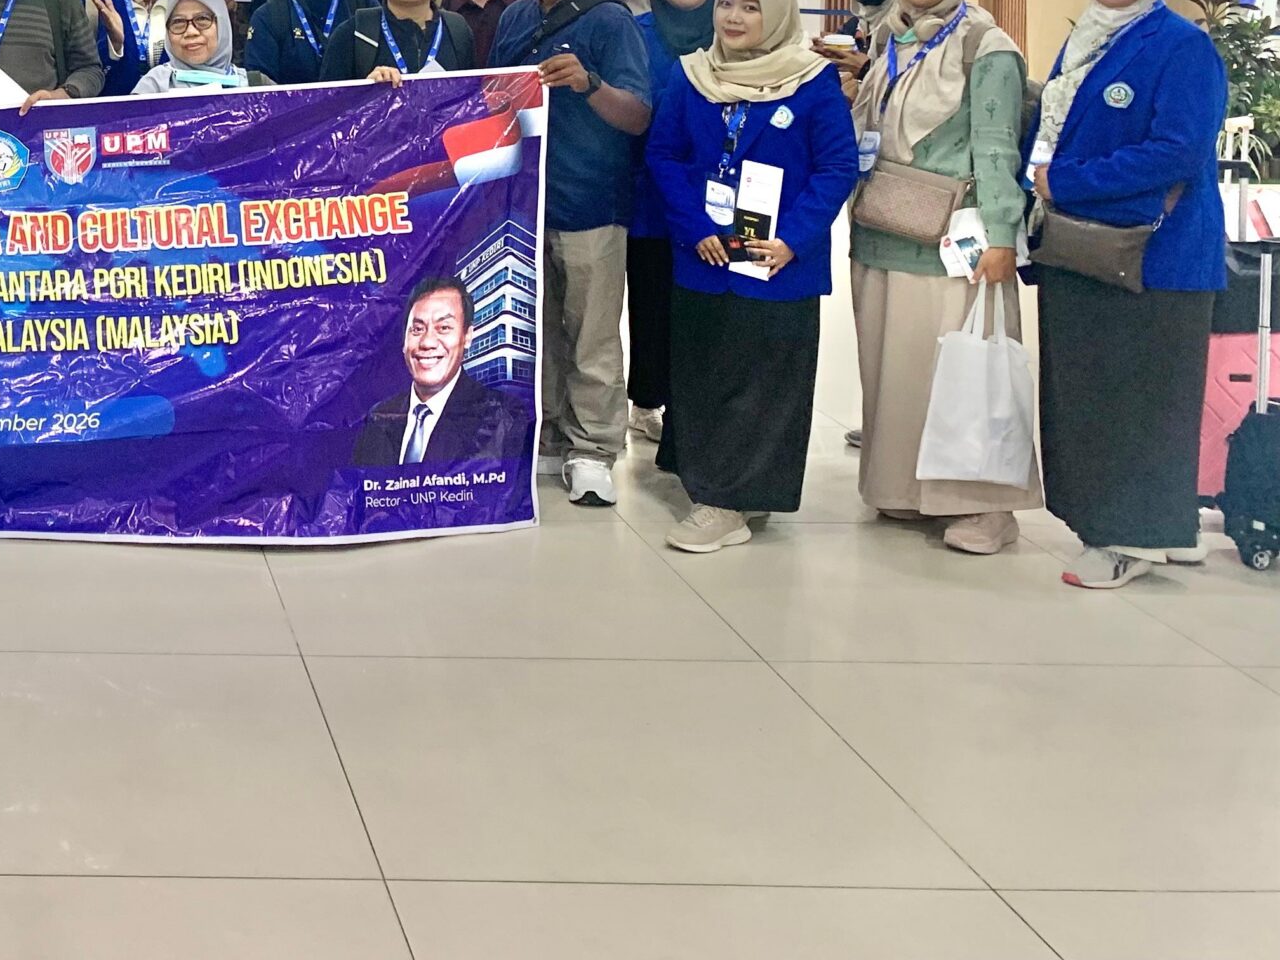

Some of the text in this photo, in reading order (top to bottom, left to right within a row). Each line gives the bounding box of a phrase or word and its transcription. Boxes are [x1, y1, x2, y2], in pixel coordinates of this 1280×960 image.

[45, 130, 68, 139] UPM
[104, 133, 167, 152] UPM
[8, 212, 77, 254] AND
[80, 203, 237, 252] CULTURAL
[242, 193, 412, 245] EXCHANGE
[94, 268, 148, 299] PGRI
[155, 263, 231, 297] KEDIRI
[238, 248, 387, 292] (INDONESIA)
[96, 310, 239, 351] (MALAYSIA)
[52, 412, 100, 431] 2026
[363, 471, 506, 491] Dr. Zainal Afandi, M.Pd
[365, 496, 400, 508] Rector
[410, 492, 437, 504] UNP
[440, 489, 474, 503] Kediri
